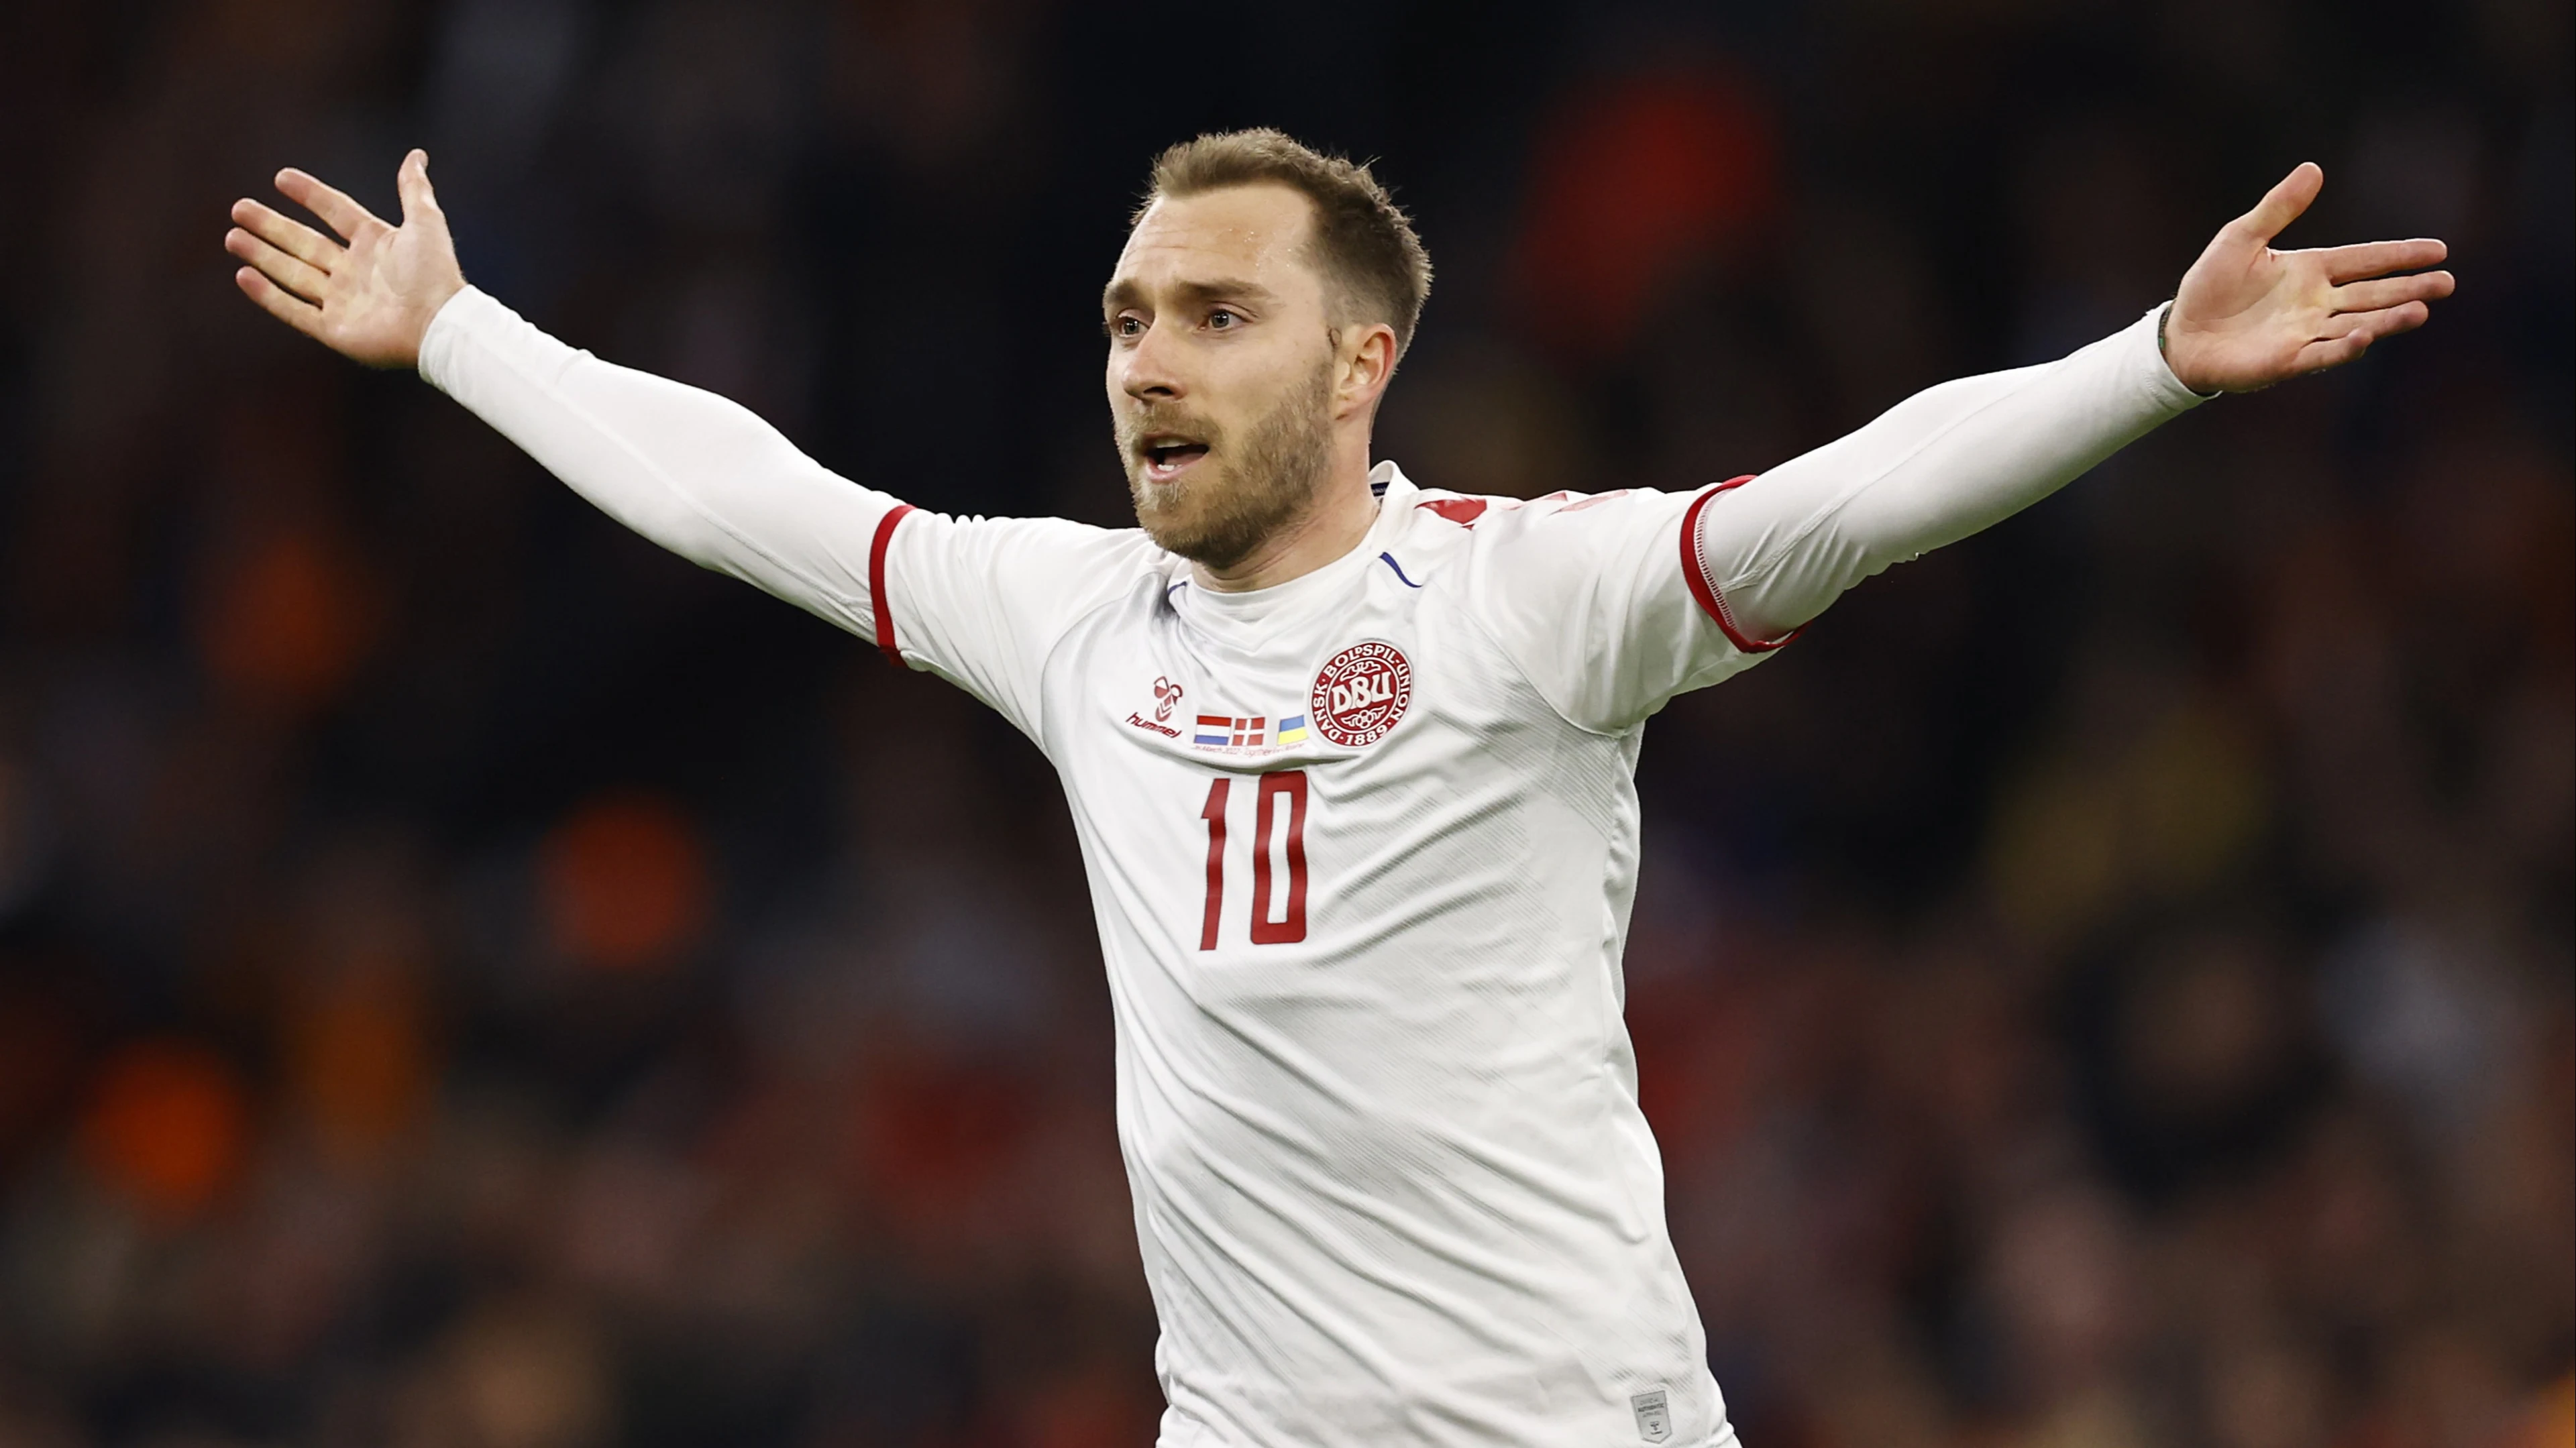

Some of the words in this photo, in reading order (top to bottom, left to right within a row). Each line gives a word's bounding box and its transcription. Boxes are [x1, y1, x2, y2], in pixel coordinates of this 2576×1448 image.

[1331, 671, 1394, 716] DBU
[1125, 712, 1183, 738] hummel
[1344, 724, 1388, 746] 1889
[1199, 770, 1308, 951] 10
